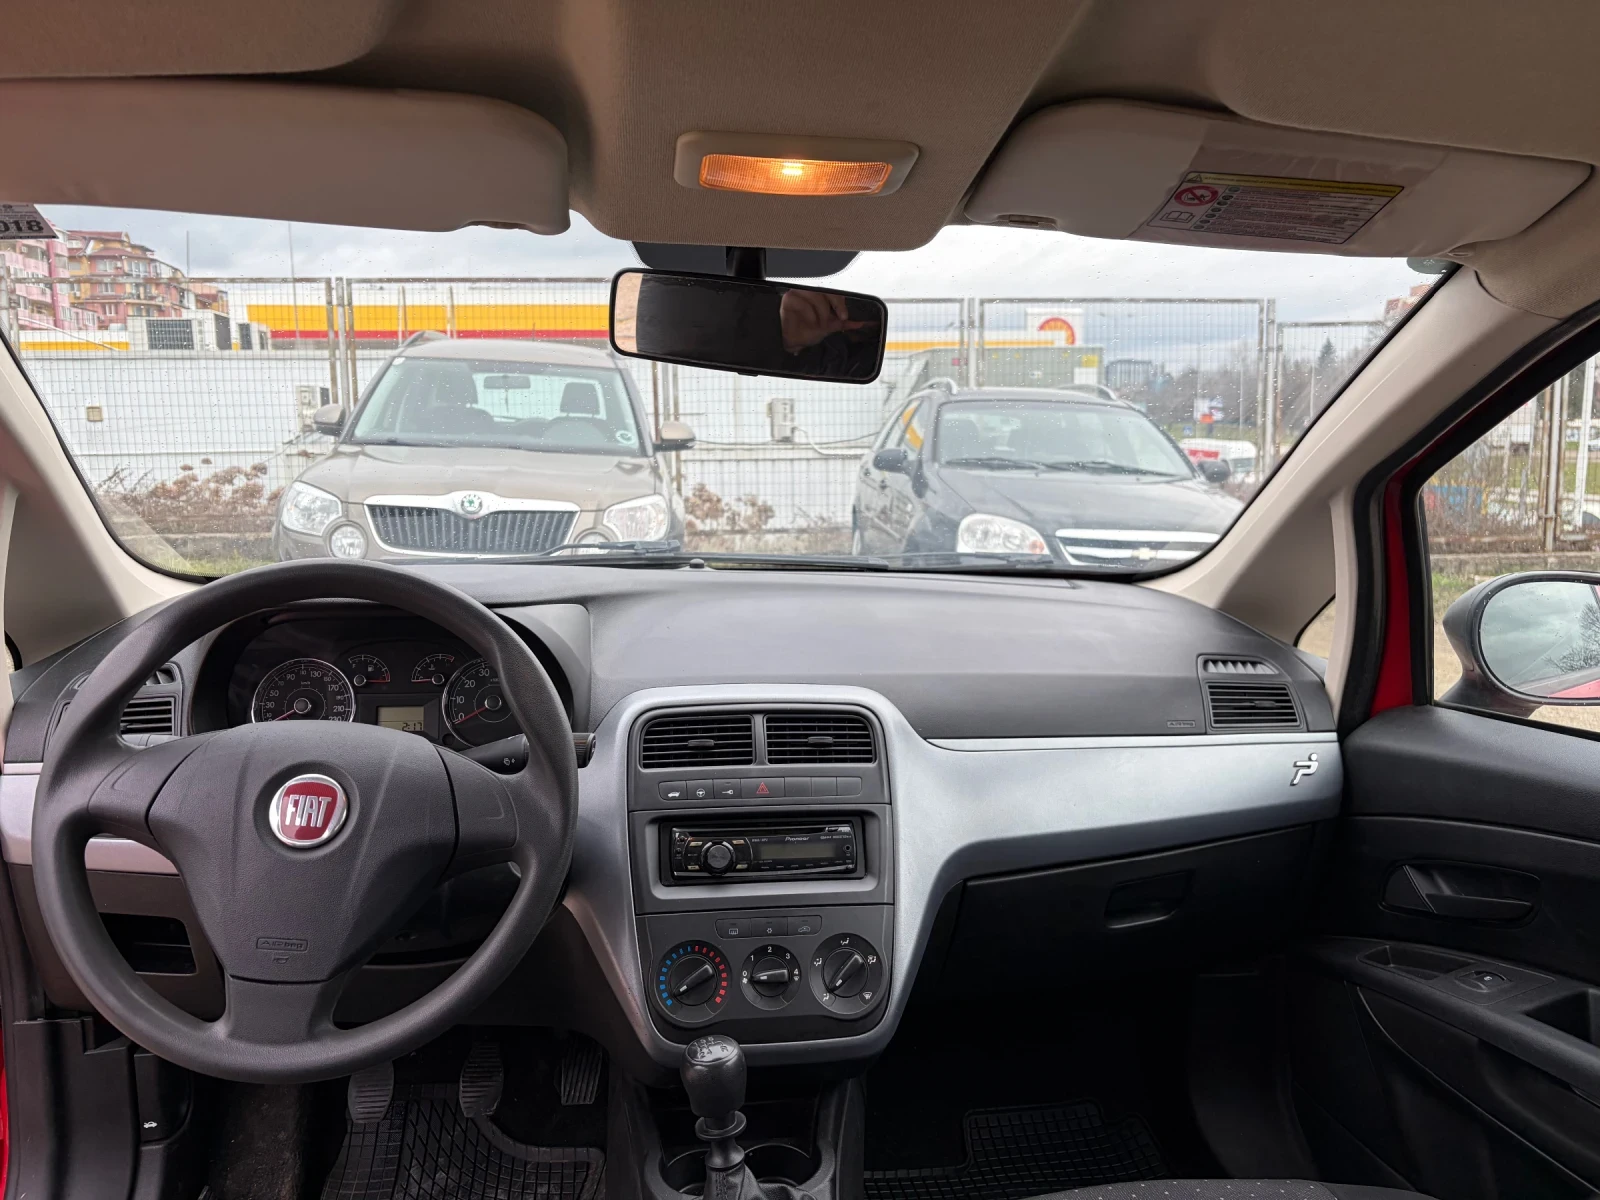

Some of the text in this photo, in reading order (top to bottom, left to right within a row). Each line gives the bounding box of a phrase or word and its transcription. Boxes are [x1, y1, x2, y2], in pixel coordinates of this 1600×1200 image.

[286, 673, 295, 681] 90
[478, 668, 490, 677] 30
[464, 679, 476, 688] 20
[456, 696, 465, 704] 10
[265, 701, 275, 709] 30
[402, 722, 423, 731] 2:17
[285, 794, 332, 828] FIAT
